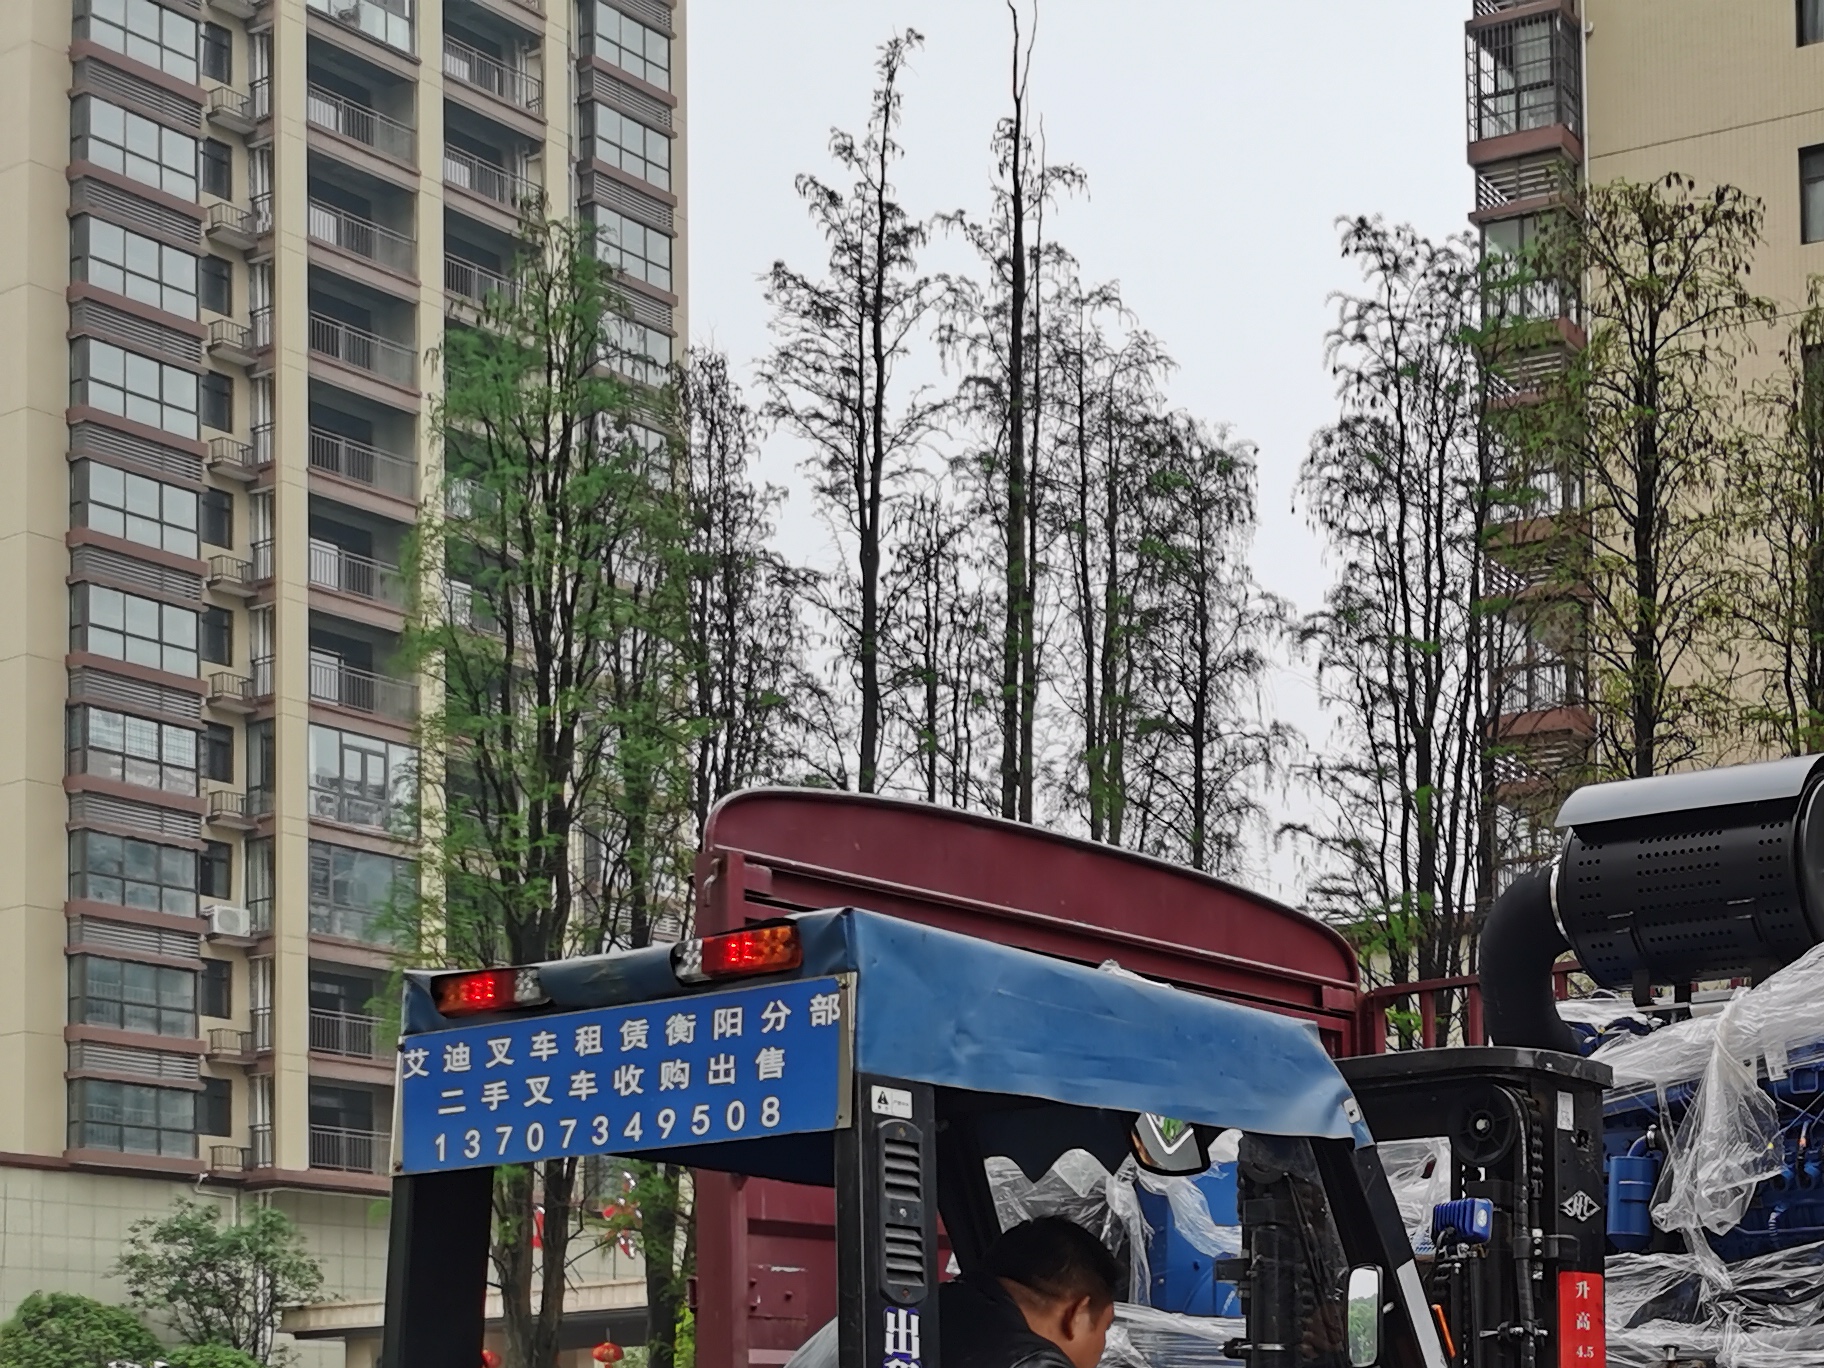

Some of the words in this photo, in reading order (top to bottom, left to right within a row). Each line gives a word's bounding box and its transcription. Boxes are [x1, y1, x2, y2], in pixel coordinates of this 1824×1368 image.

[403, 993, 841, 1079] 艾迪叉车租赁衡阳分部
[438, 1046, 786, 1116] 二手叉车收购出售
[434, 1095, 781, 1162] 13707349508
